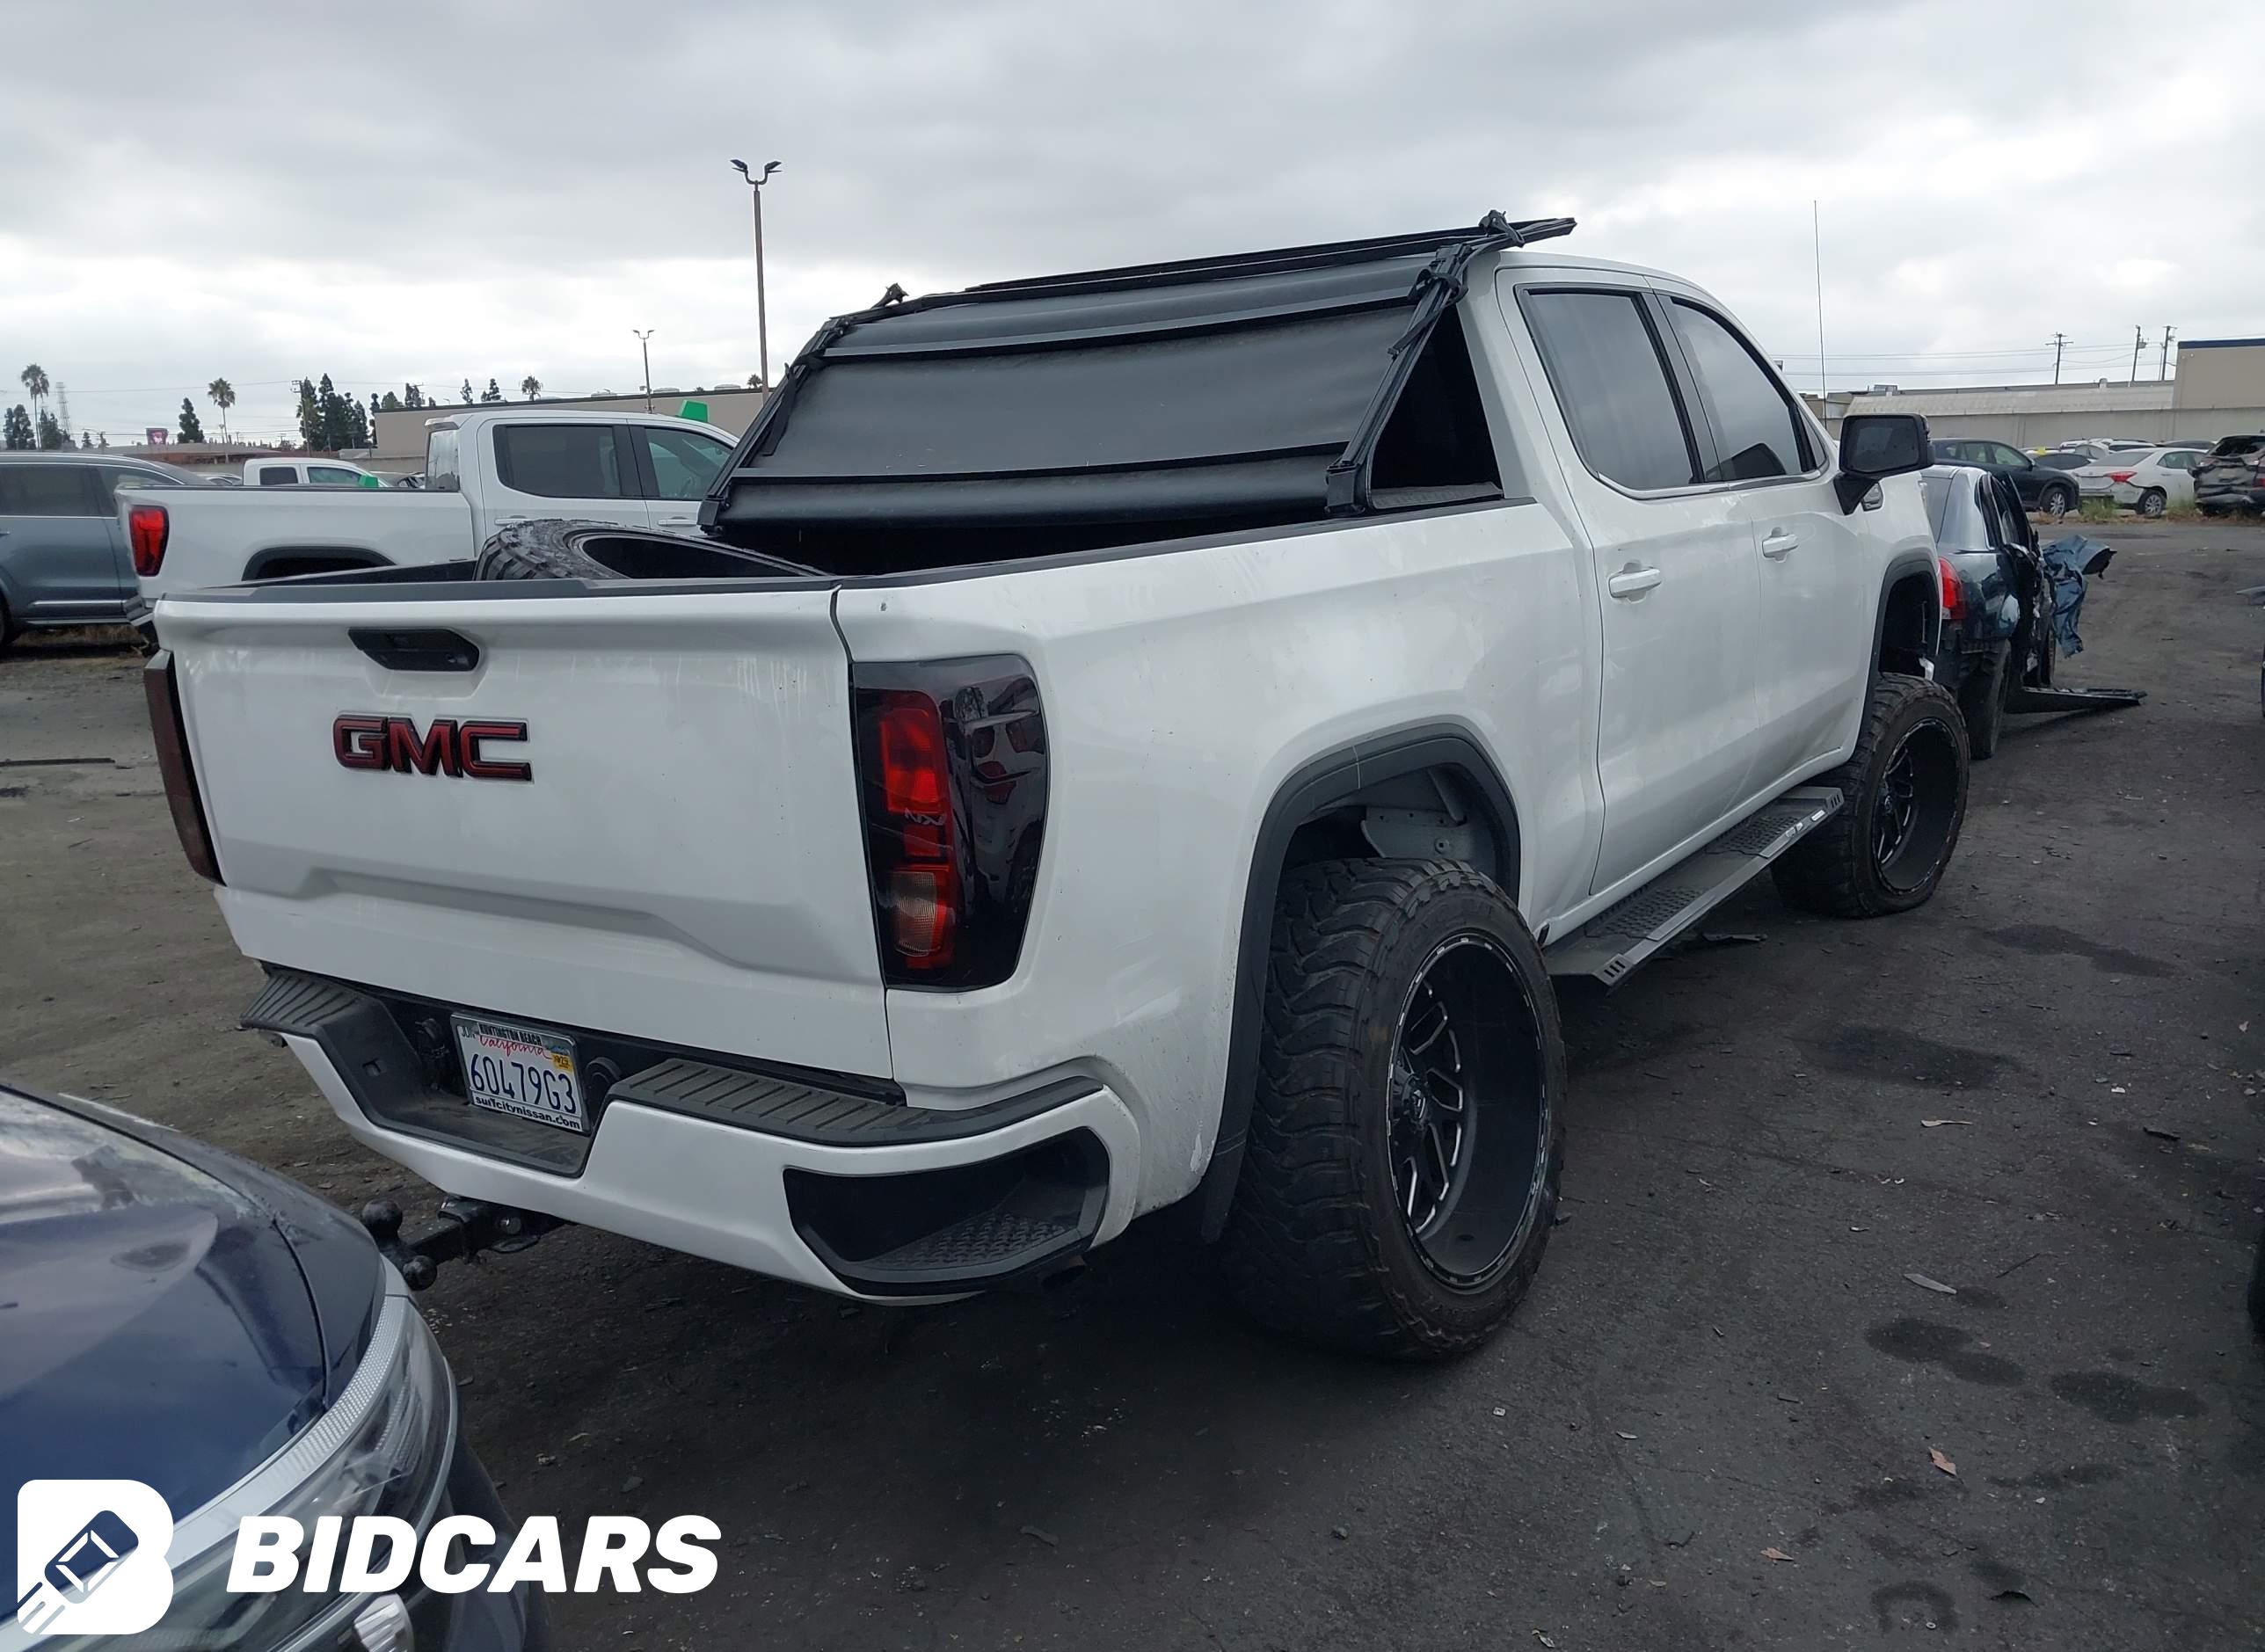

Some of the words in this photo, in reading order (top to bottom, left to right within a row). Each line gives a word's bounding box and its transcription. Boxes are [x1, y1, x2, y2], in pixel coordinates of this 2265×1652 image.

[333, 713, 532, 782] GMC
[519, 1030, 543, 1047] BEACH
[470, 1053, 577, 1114] 60479G3
[475, 1096, 580, 1130] surfcitynissan.com
